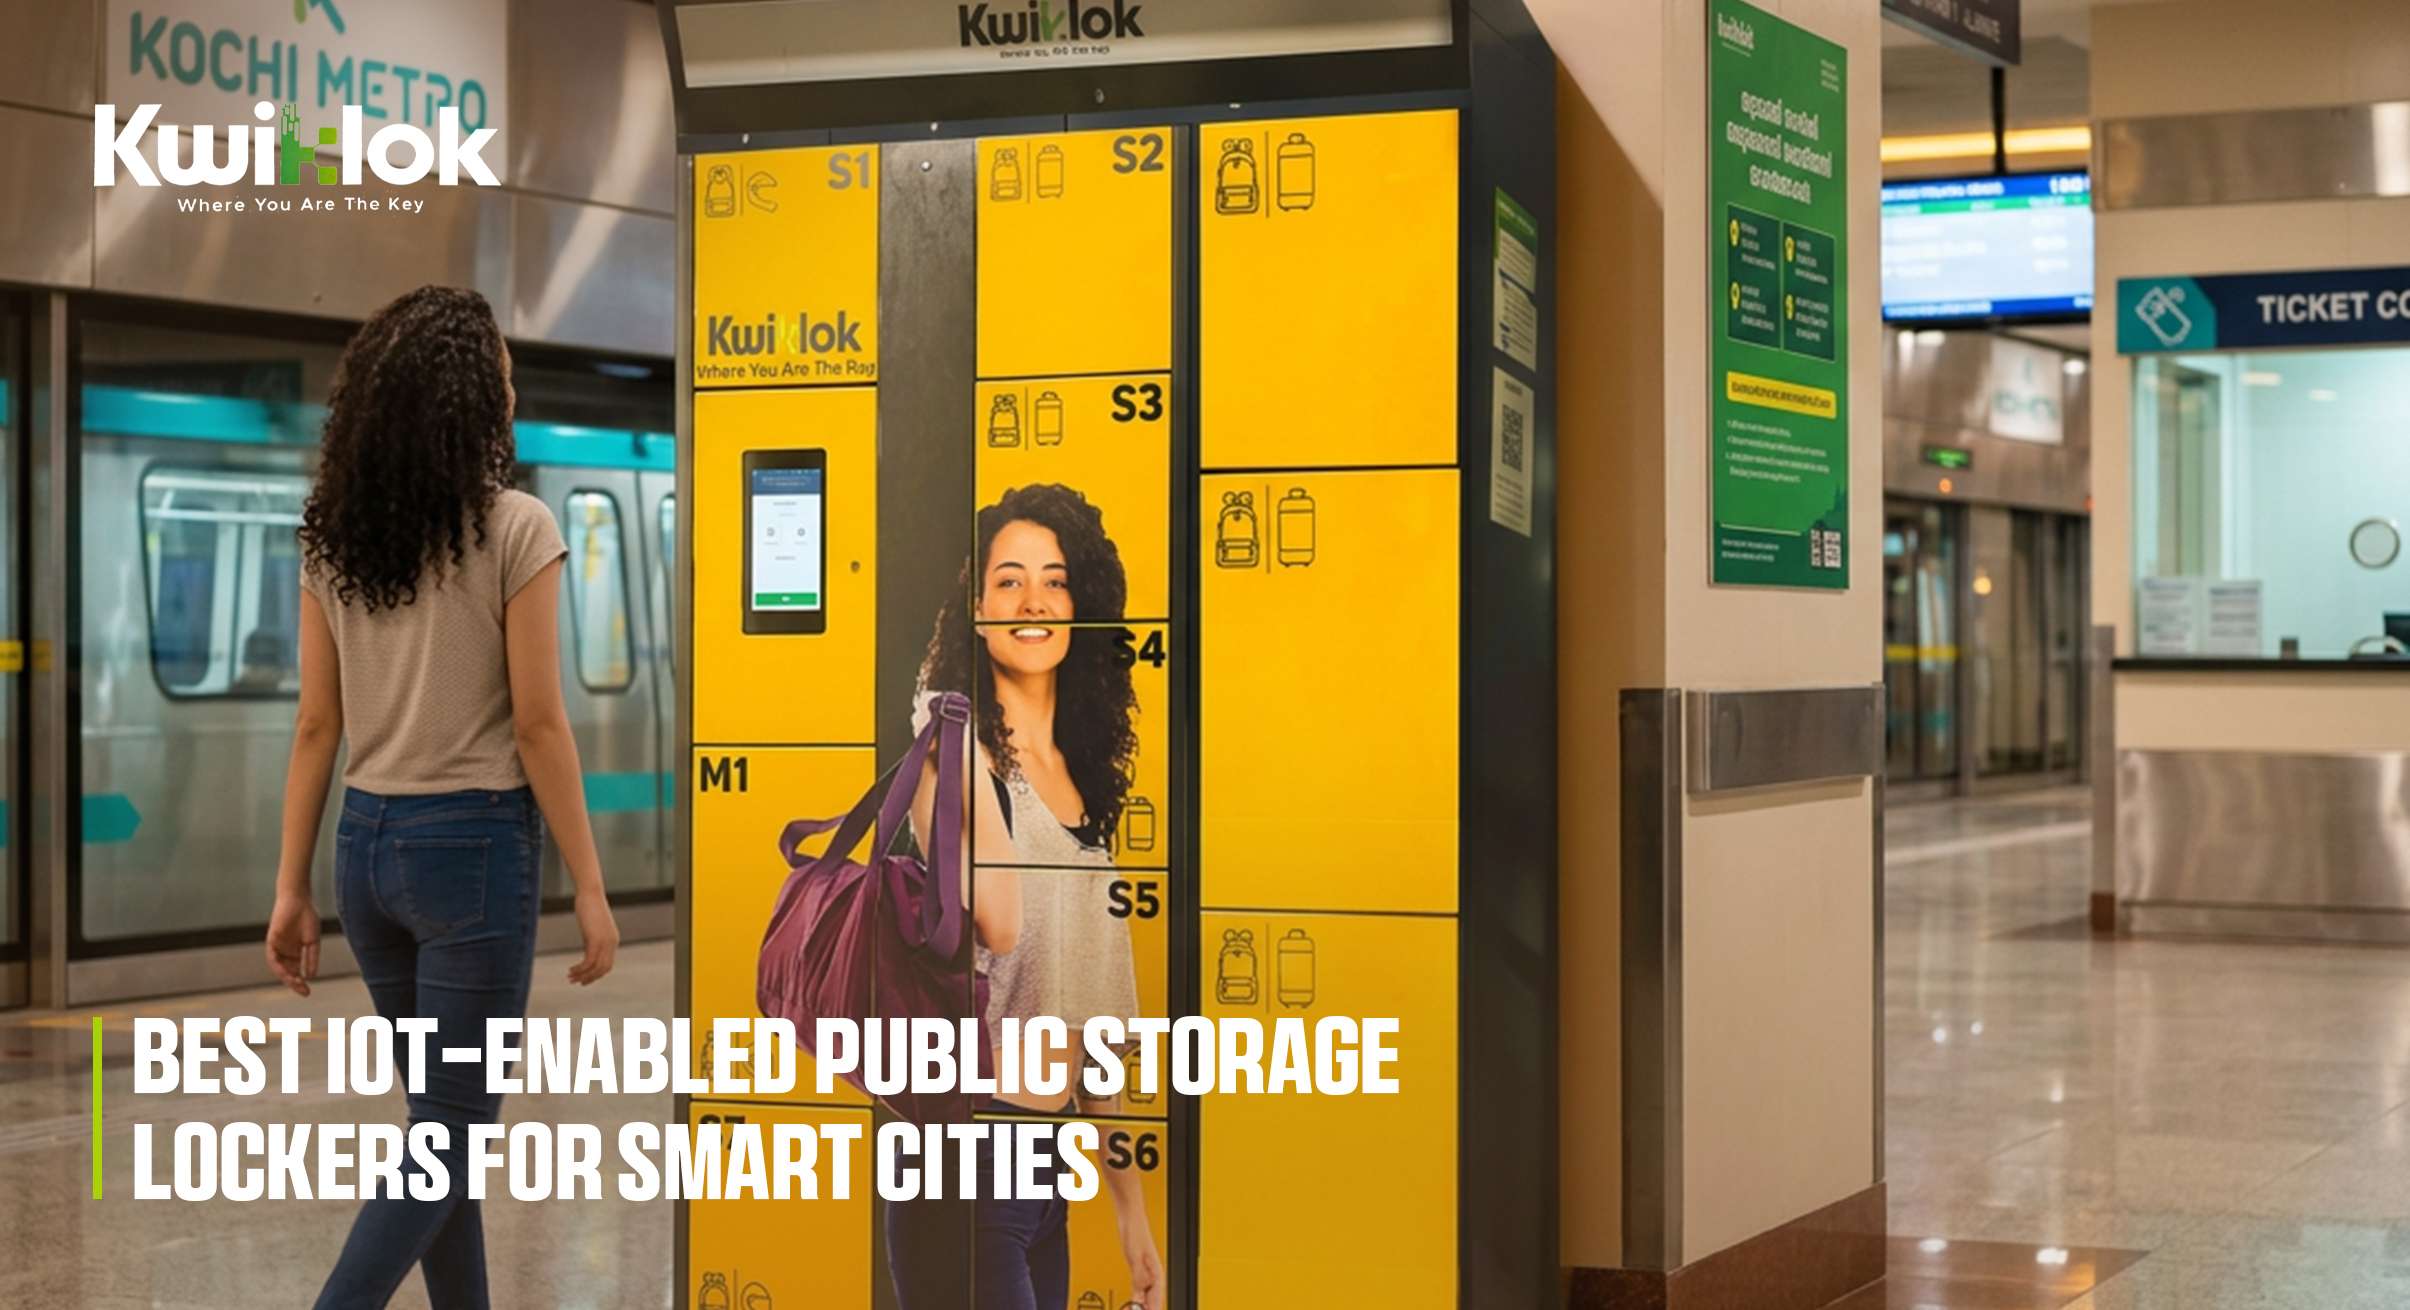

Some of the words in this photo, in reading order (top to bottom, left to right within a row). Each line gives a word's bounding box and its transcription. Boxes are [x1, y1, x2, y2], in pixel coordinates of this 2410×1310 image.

[130, 10, 298, 102] KOCHI
[318, 49, 488, 135] METRO
[827, 153, 870, 190] S1
[1112, 134, 1164, 174] S2
[2256, 291, 2369, 323] TICKET
[815, 359, 843, 375] The
[1111, 383, 1163, 423] S3
[699, 756, 749, 793] M1
[1107, 881, 1160, 919] S5
[1106, 1132, 1160, 1172] S6
